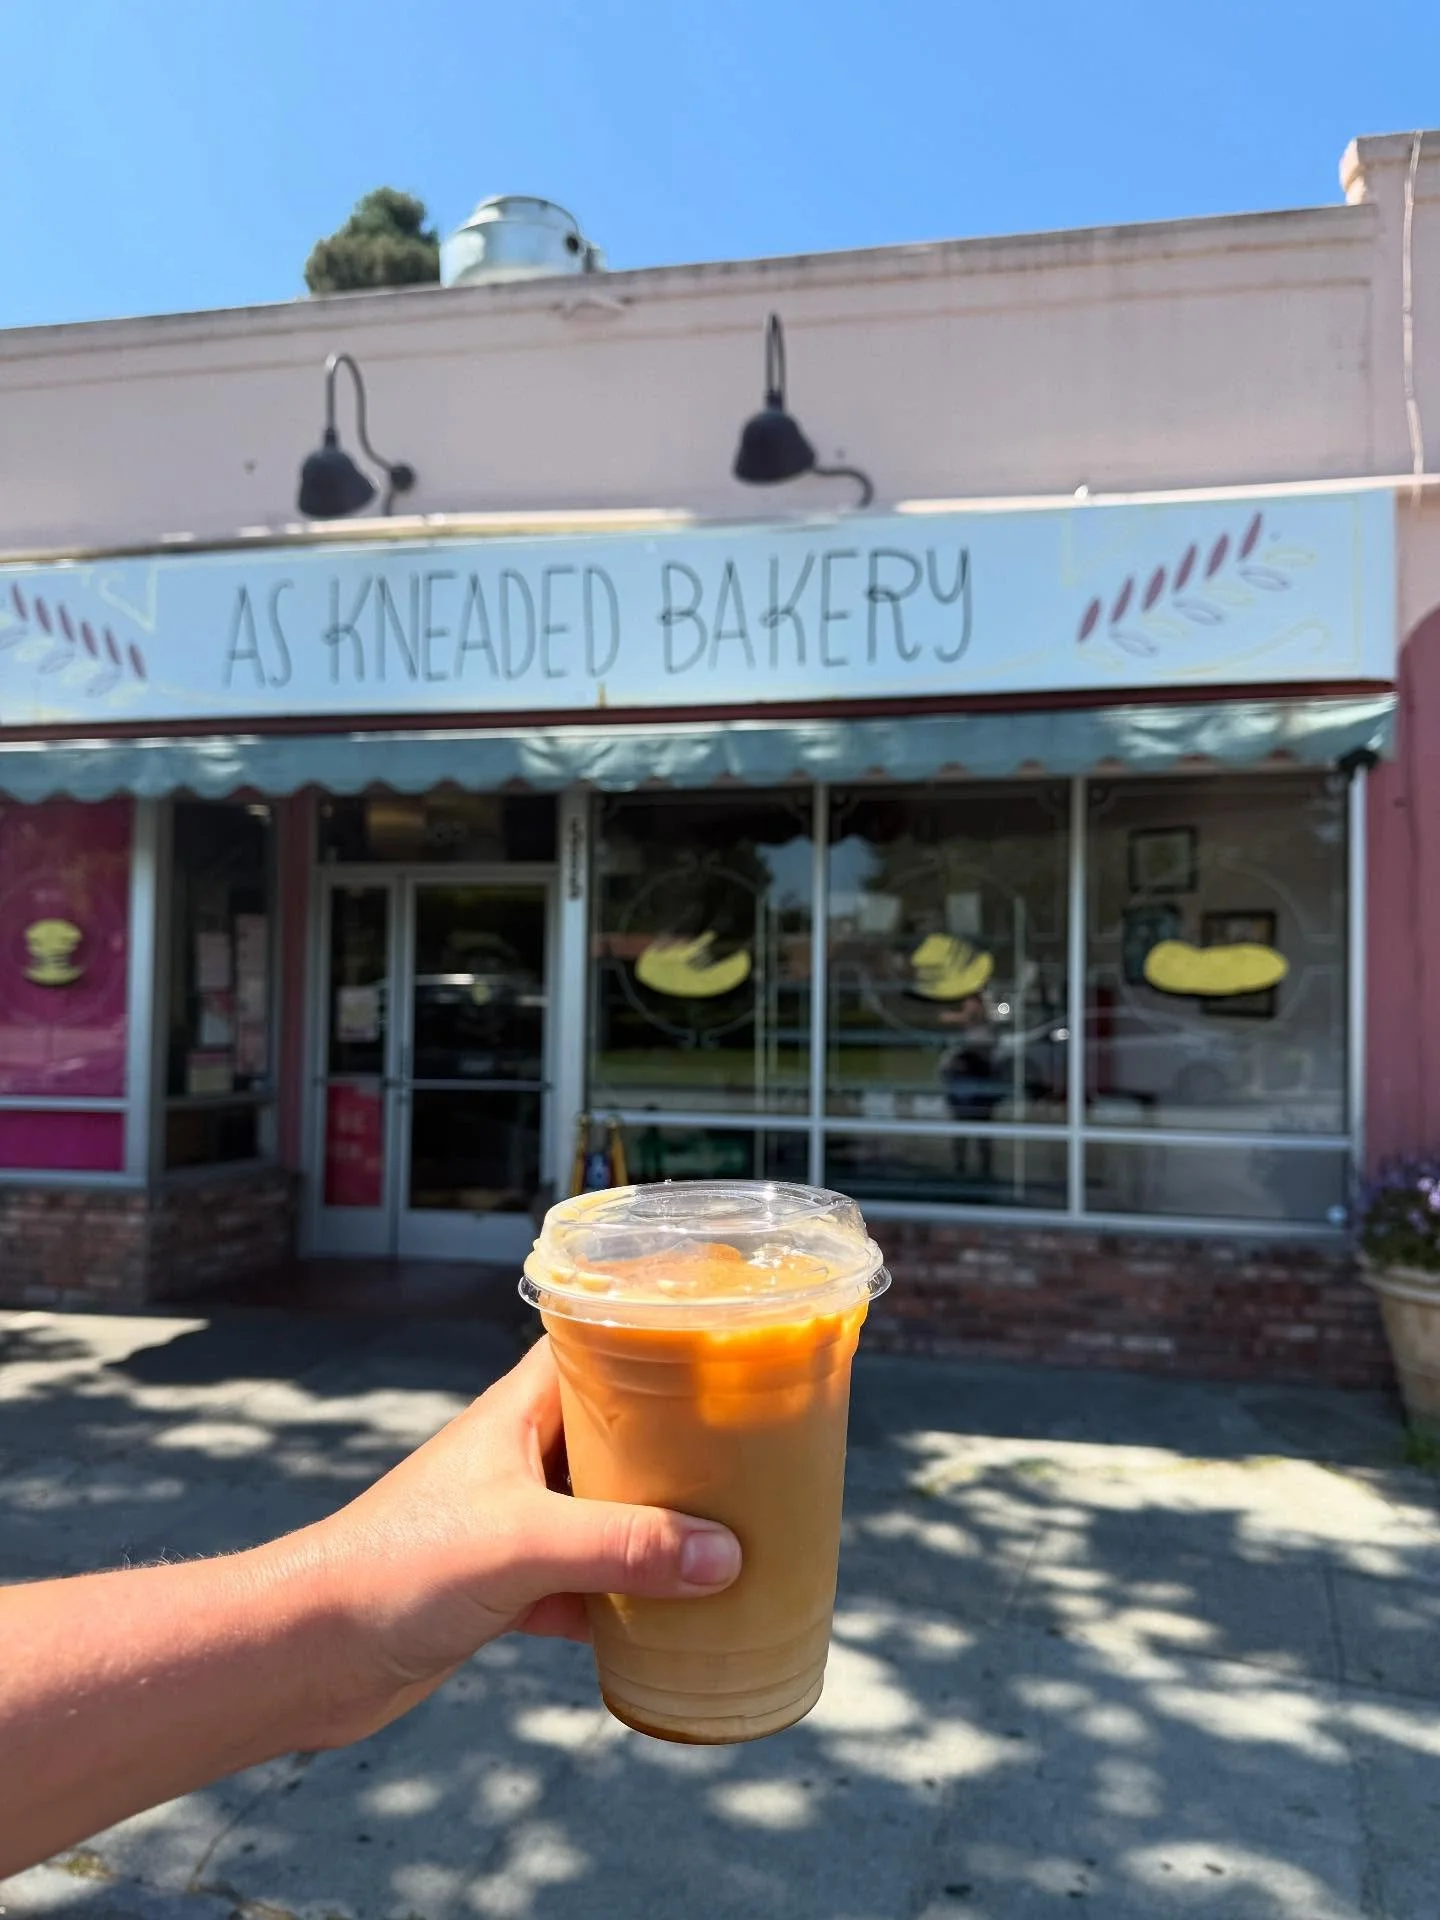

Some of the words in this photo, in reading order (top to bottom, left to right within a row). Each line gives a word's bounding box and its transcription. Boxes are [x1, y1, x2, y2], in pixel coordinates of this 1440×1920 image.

[221, 578, 294, 689] AS
[321, 565, 620, 684] KNEADED
[657, 546, 972, 674] BAKERY
